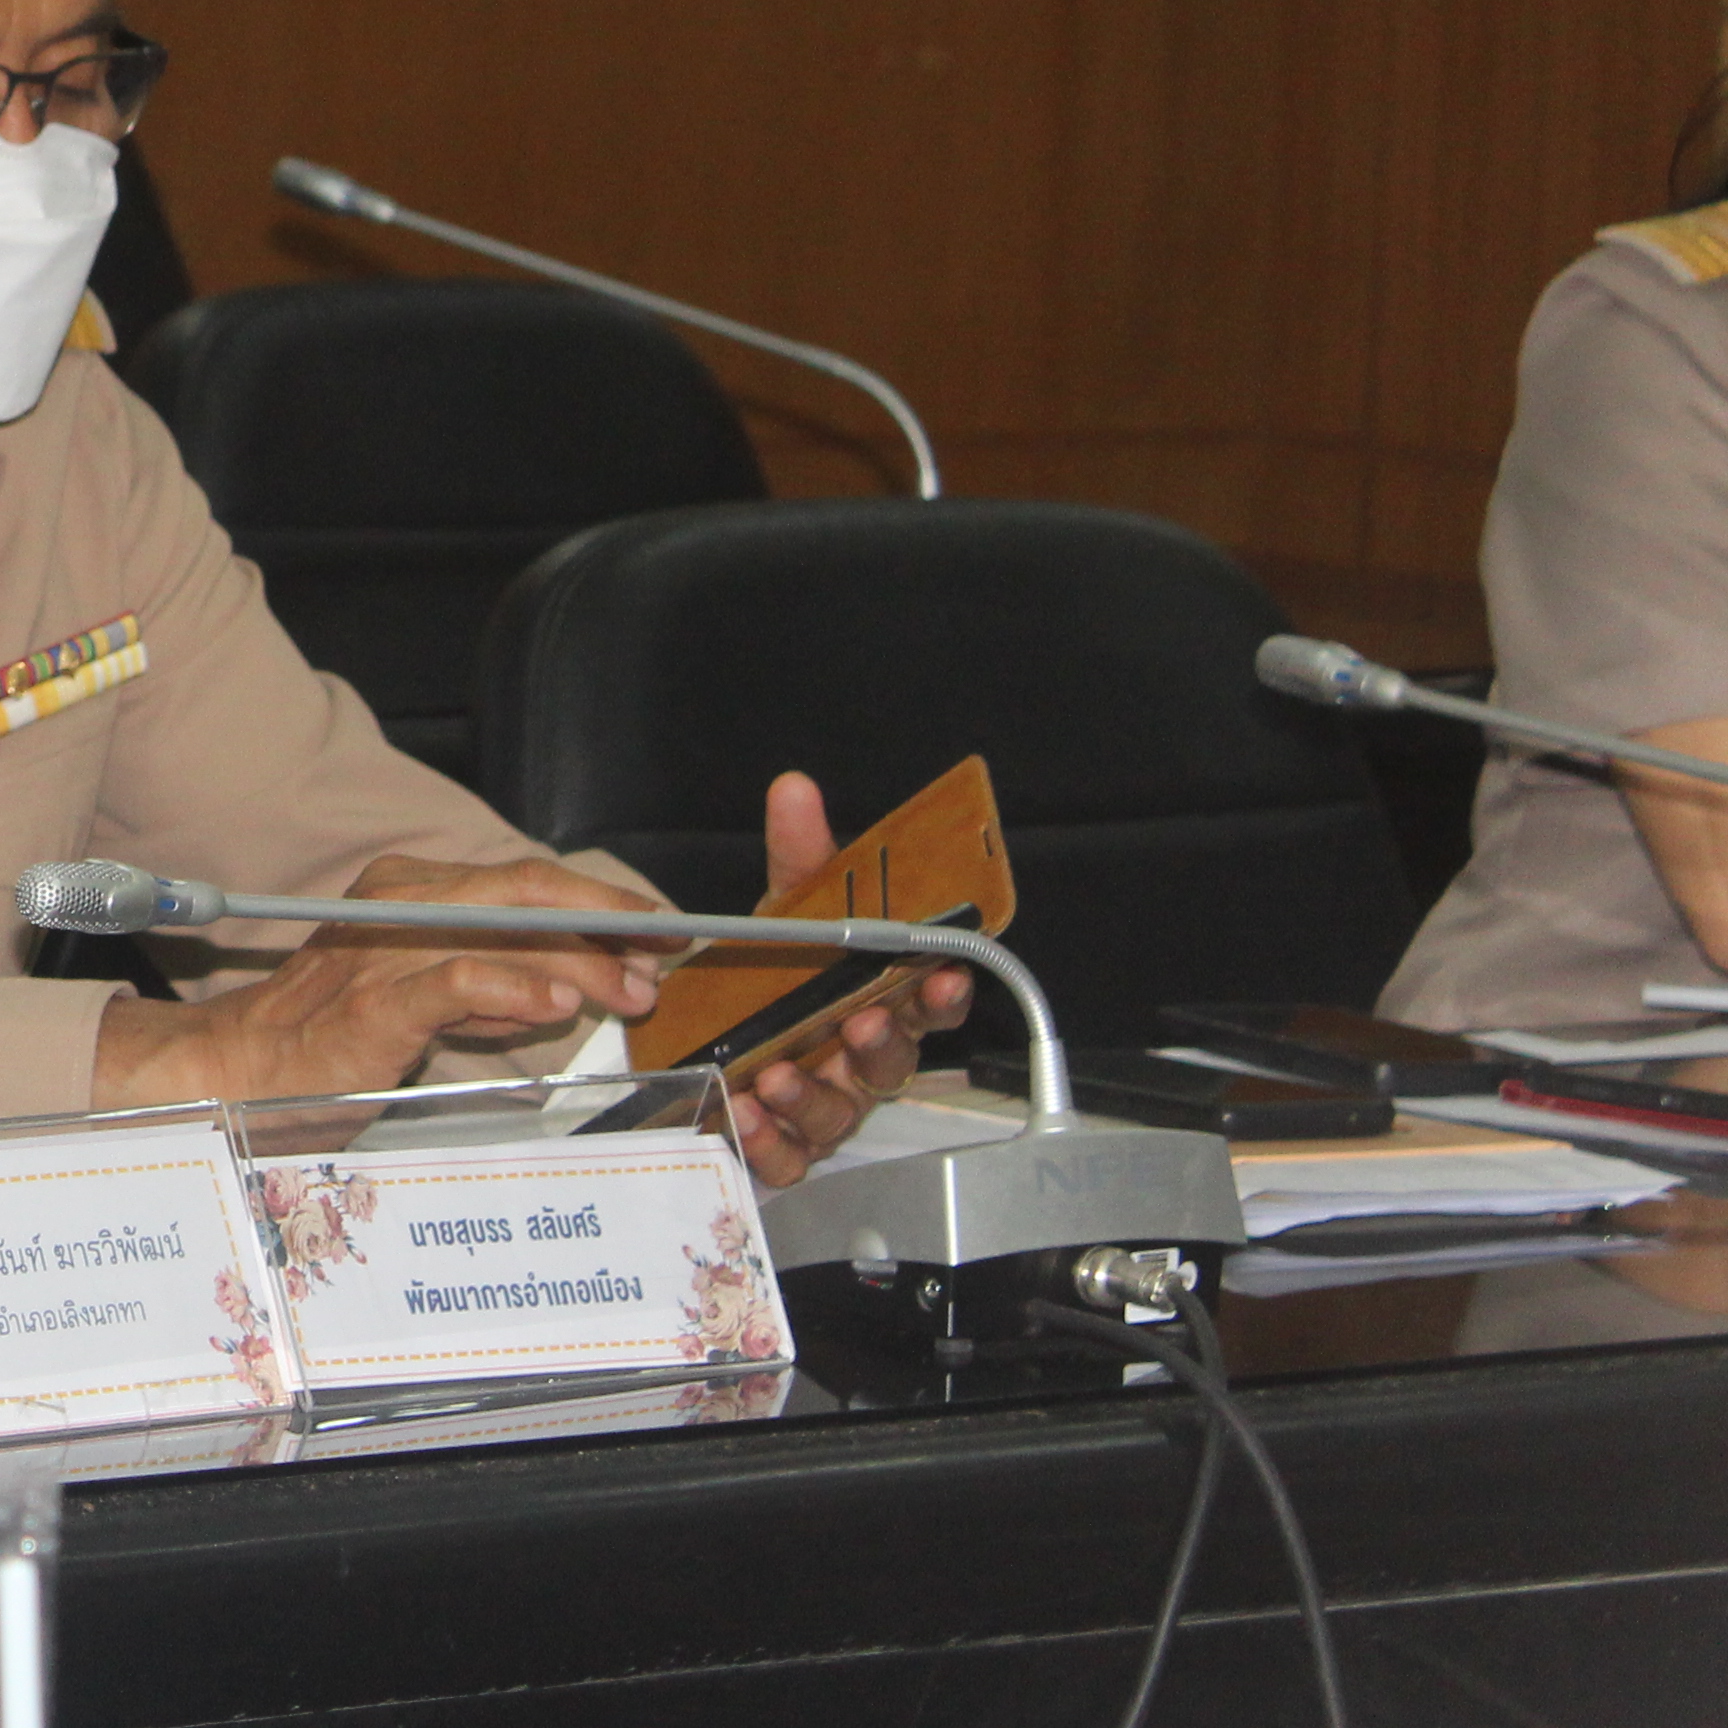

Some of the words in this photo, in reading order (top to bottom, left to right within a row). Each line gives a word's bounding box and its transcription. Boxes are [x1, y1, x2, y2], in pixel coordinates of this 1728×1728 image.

[409, 1215, 514, 1258] นายสุบรร
[526, 1203, 603, 1242] สลับศรี
[403, 1268, 644, 1316] พัฒนาการอำเภอเมือง
